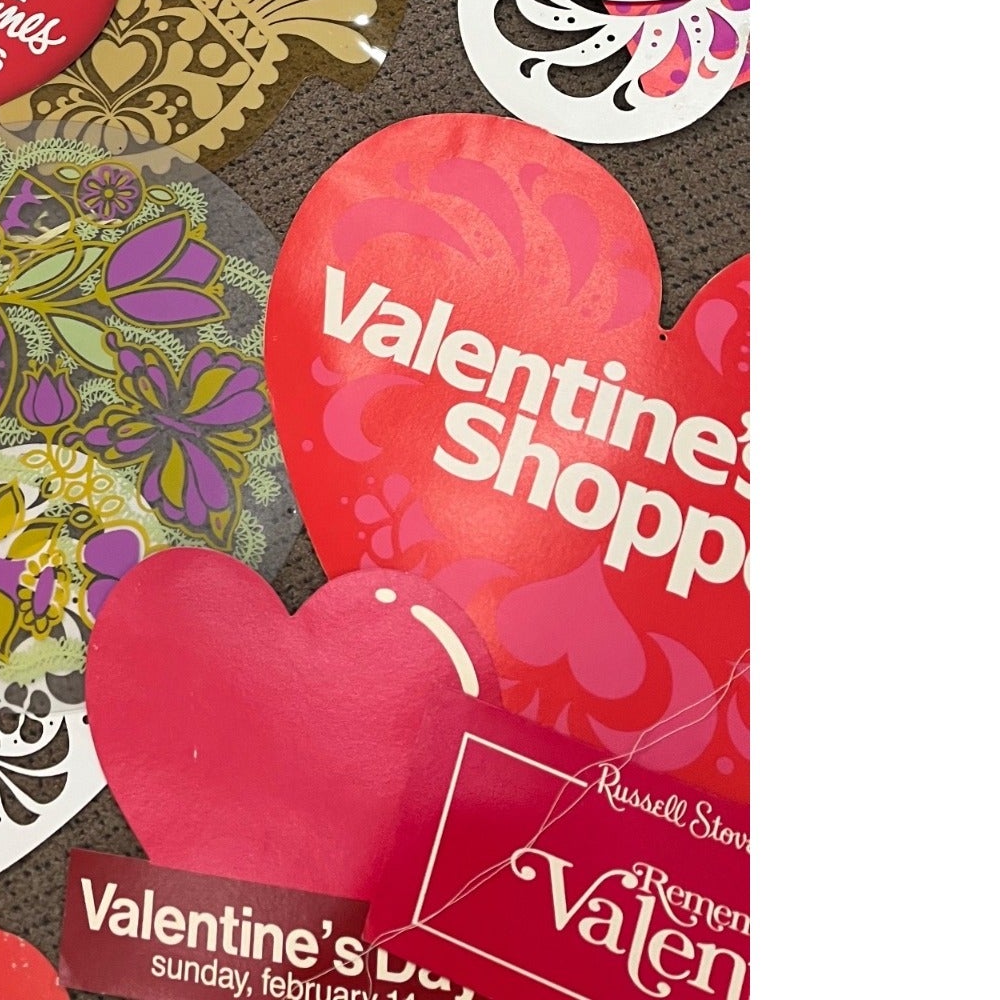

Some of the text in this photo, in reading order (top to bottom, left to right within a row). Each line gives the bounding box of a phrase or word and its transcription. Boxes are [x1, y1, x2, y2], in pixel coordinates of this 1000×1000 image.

[432, 402, 750, 599] Shopp
[598, 763, 687, 828] Russell
[81, 878, 364, 977] Valentine's
[511, 847, 750, 1000] Valen
[151, 954, 253, 998] sunday,
